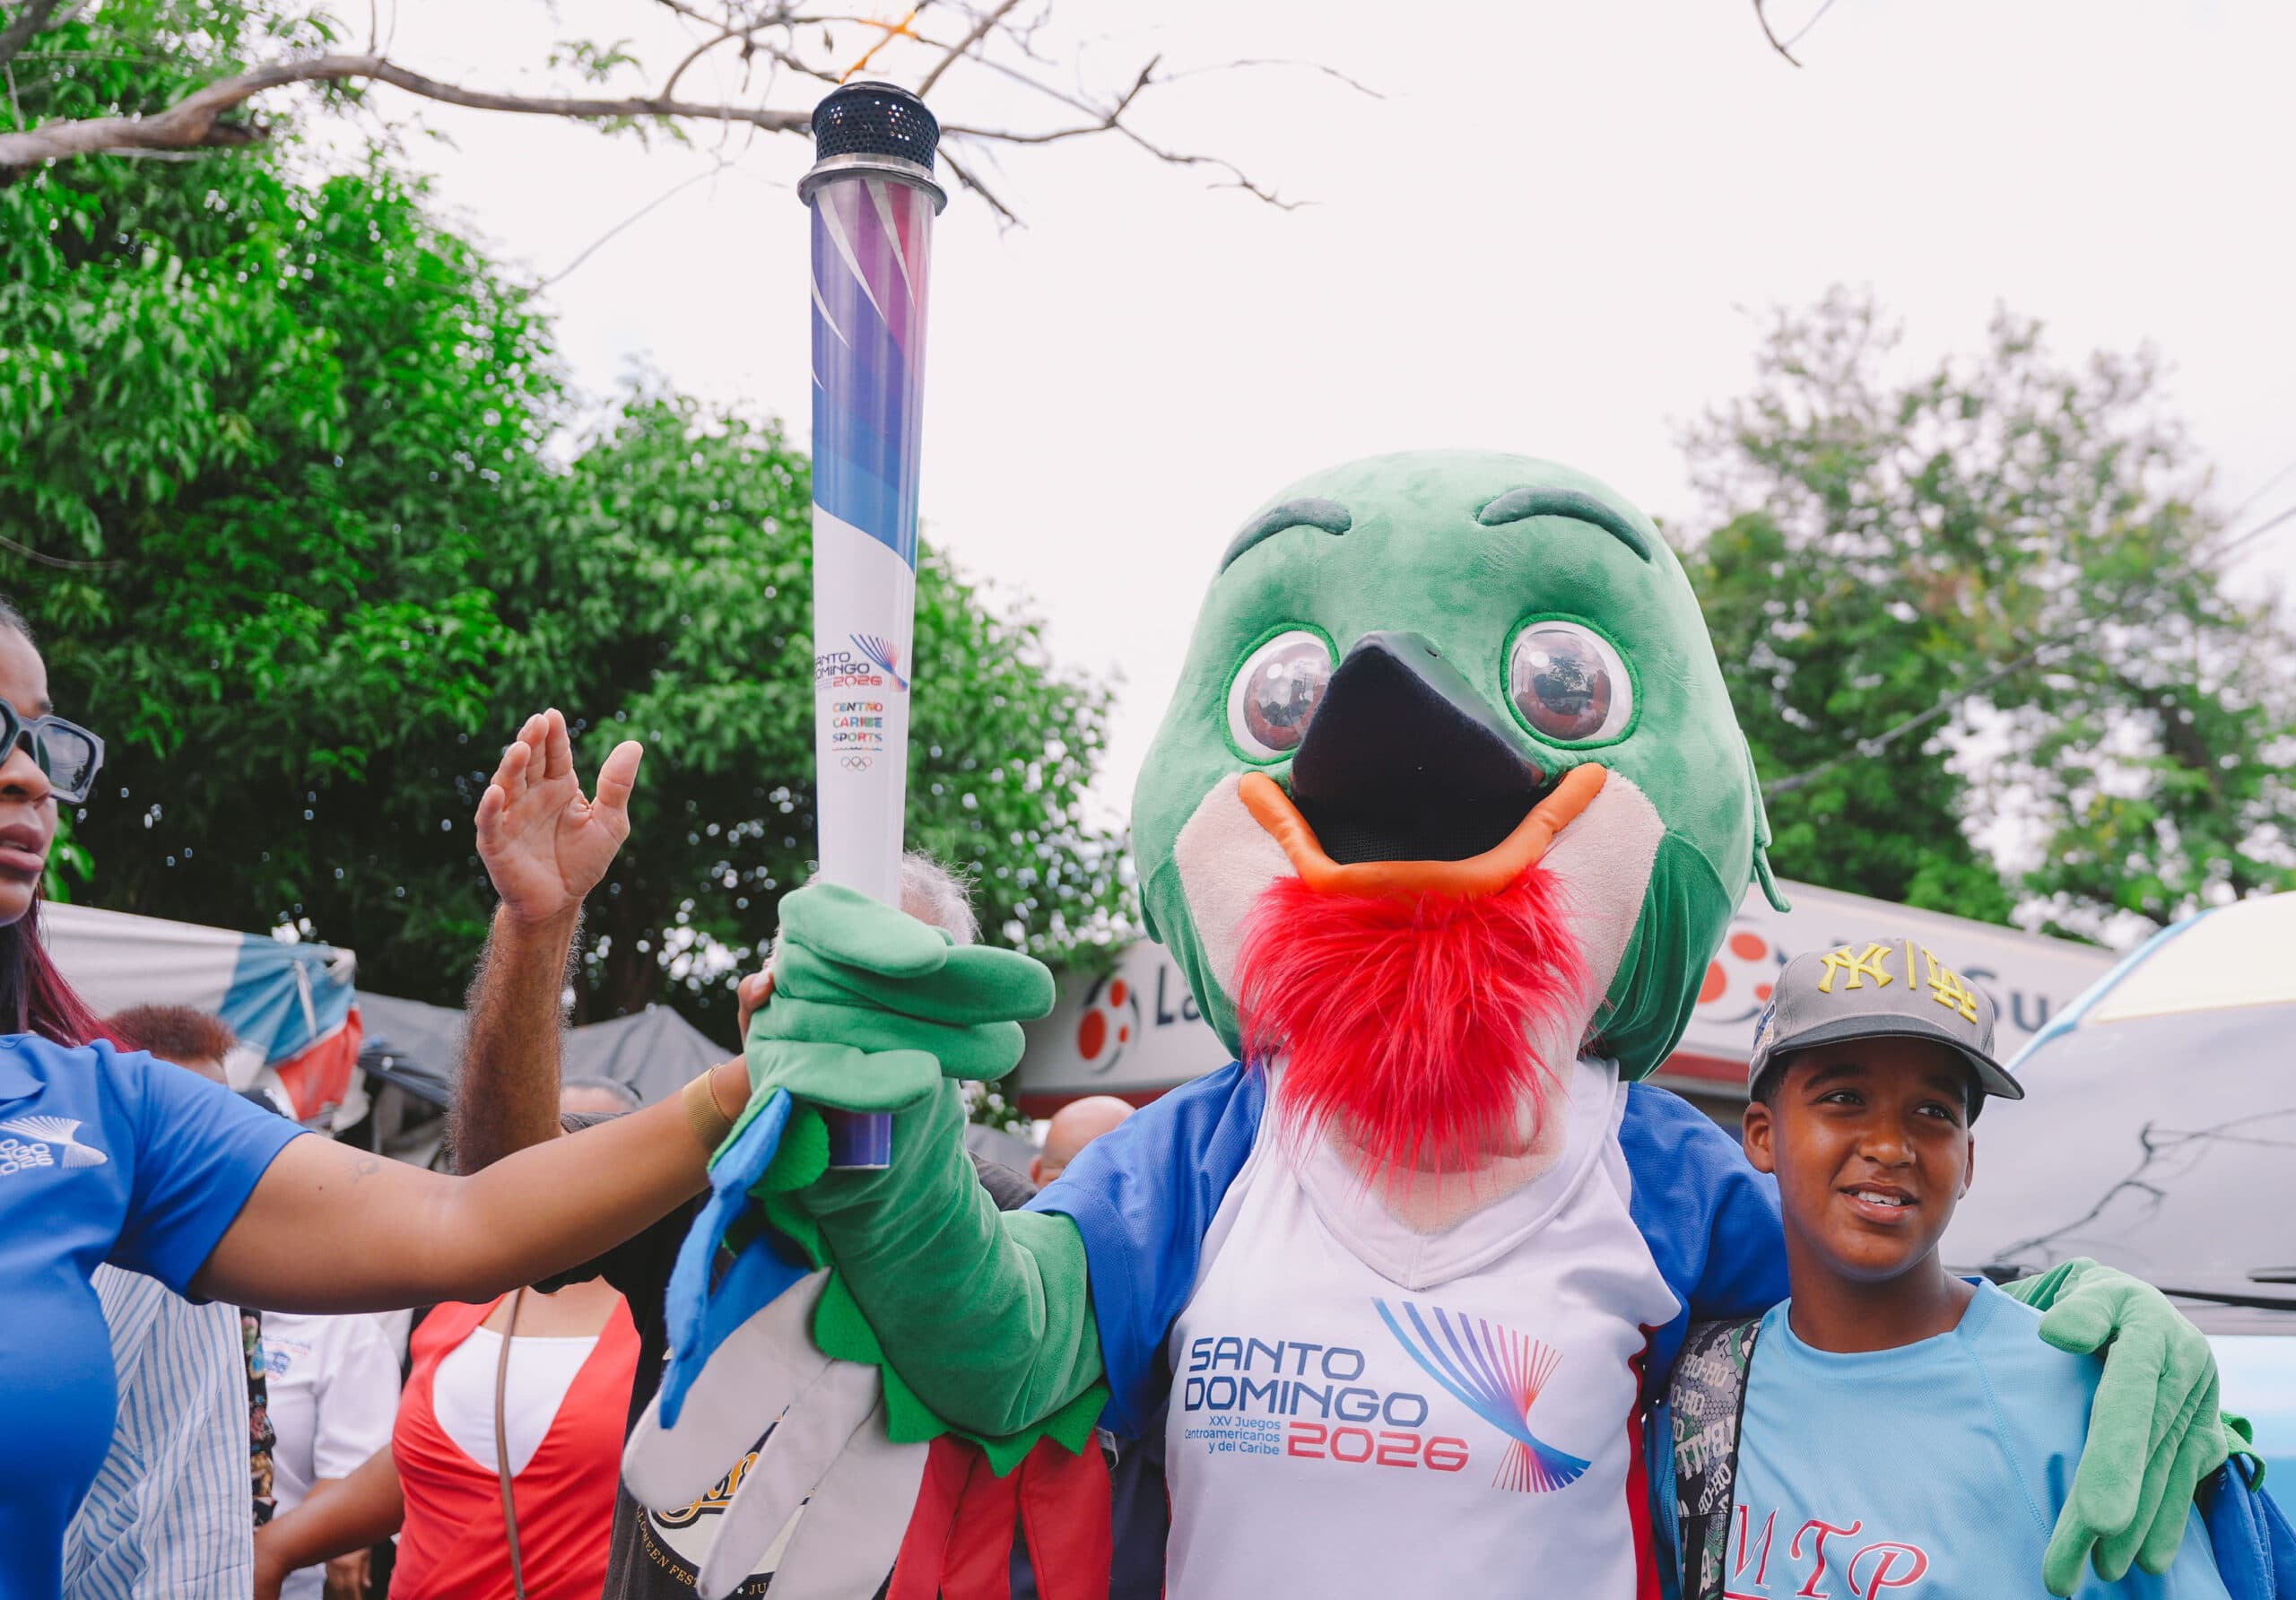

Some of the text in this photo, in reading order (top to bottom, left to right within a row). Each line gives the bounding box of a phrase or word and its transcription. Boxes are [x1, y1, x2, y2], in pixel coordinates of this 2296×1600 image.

[815, 652, 851, 665] ANTO
[814, 663, 870, 681] OMINGO
[832, 674, 883, 689] 2026
[832, 702, 883, 712] CENTRO
[832, 717, 883, 728] CARIBE
[832, 732, 883, 743] SPORTS
[1188, 1336, 1365, 1380] SANTO
[1184, 1376, 1429, 1428] DOMINGO
[1209, 1415, 1282, 1431] XXV Juegos
[1185, 1429, 1281, 1443] Centroamericanos
[1208, 1440, 1280, 1455] y del Caribe
[1288, 1422, 1469, 1472] 2026
